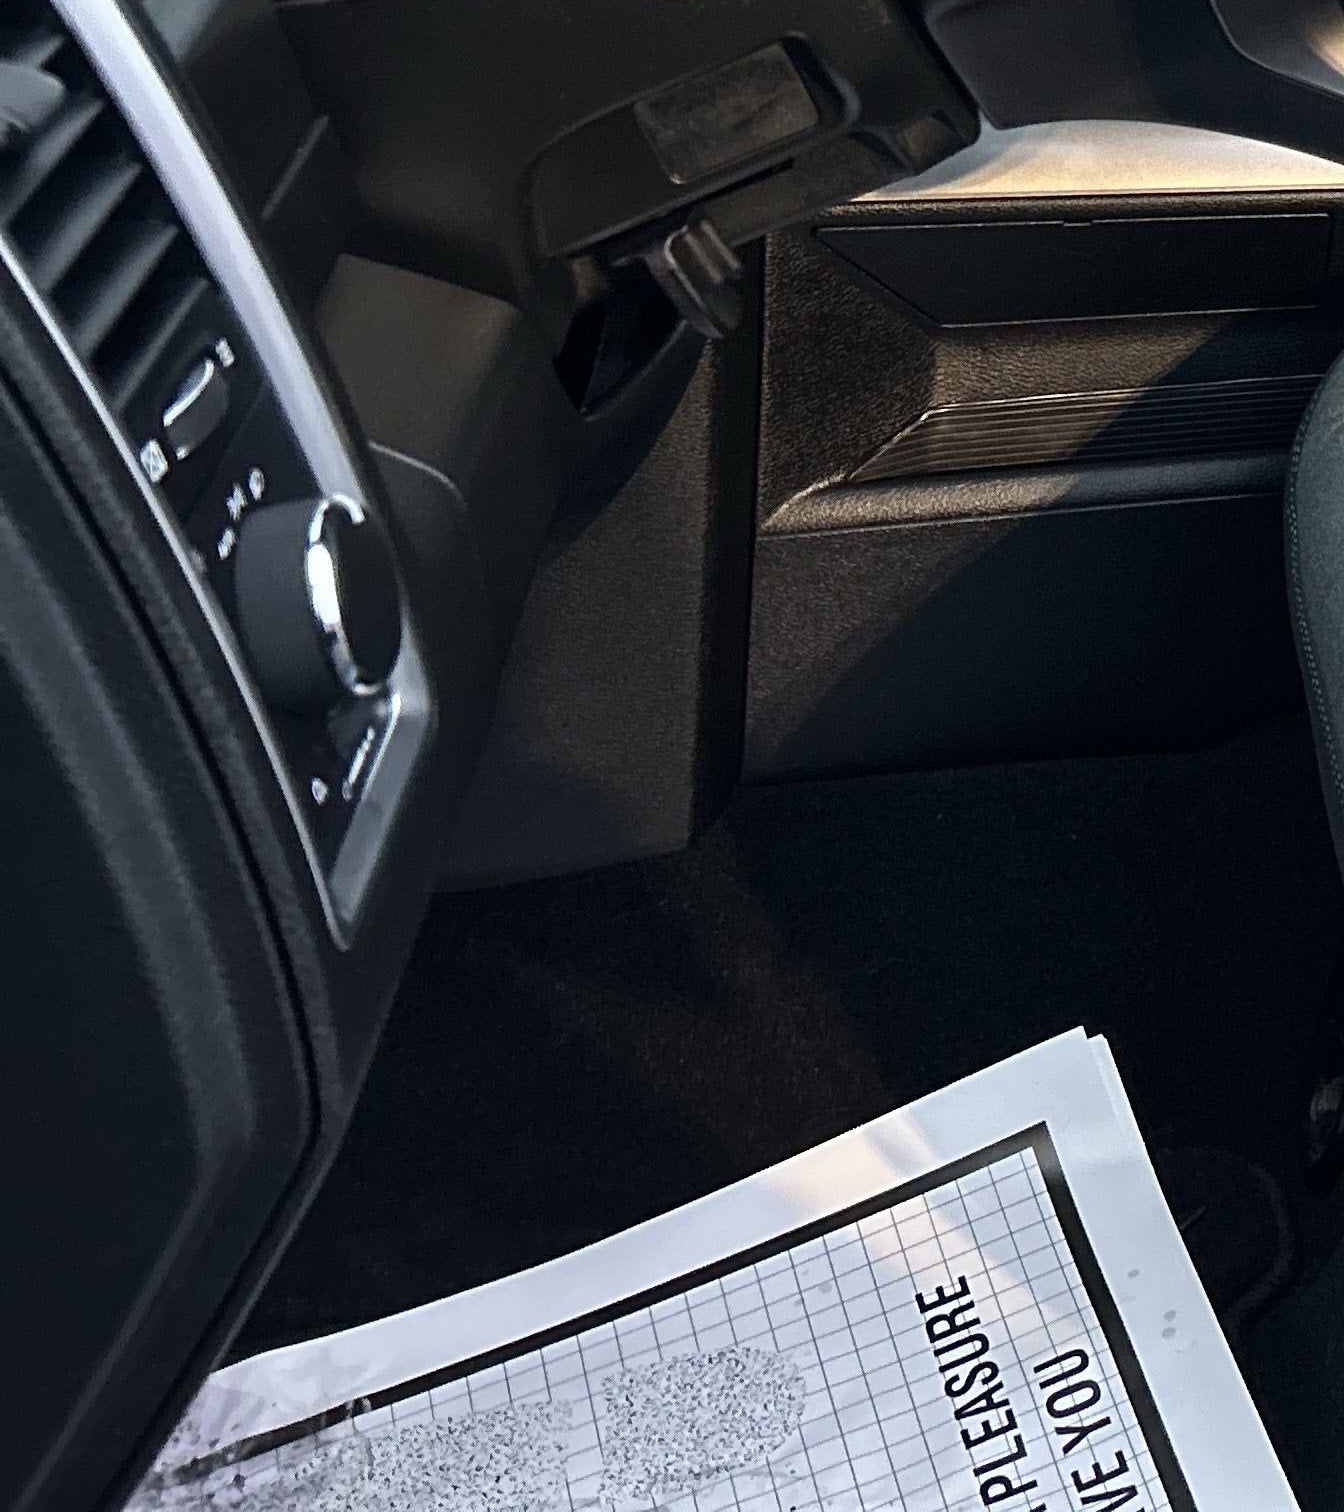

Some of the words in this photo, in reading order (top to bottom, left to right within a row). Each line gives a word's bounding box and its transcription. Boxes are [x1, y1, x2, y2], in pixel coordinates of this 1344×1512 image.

[915, 1275, 1038, 1506] PLEASURE
[1033, 1348, 1112, 1455] YOU
[1070, 1450, 1147, 1512] VE
